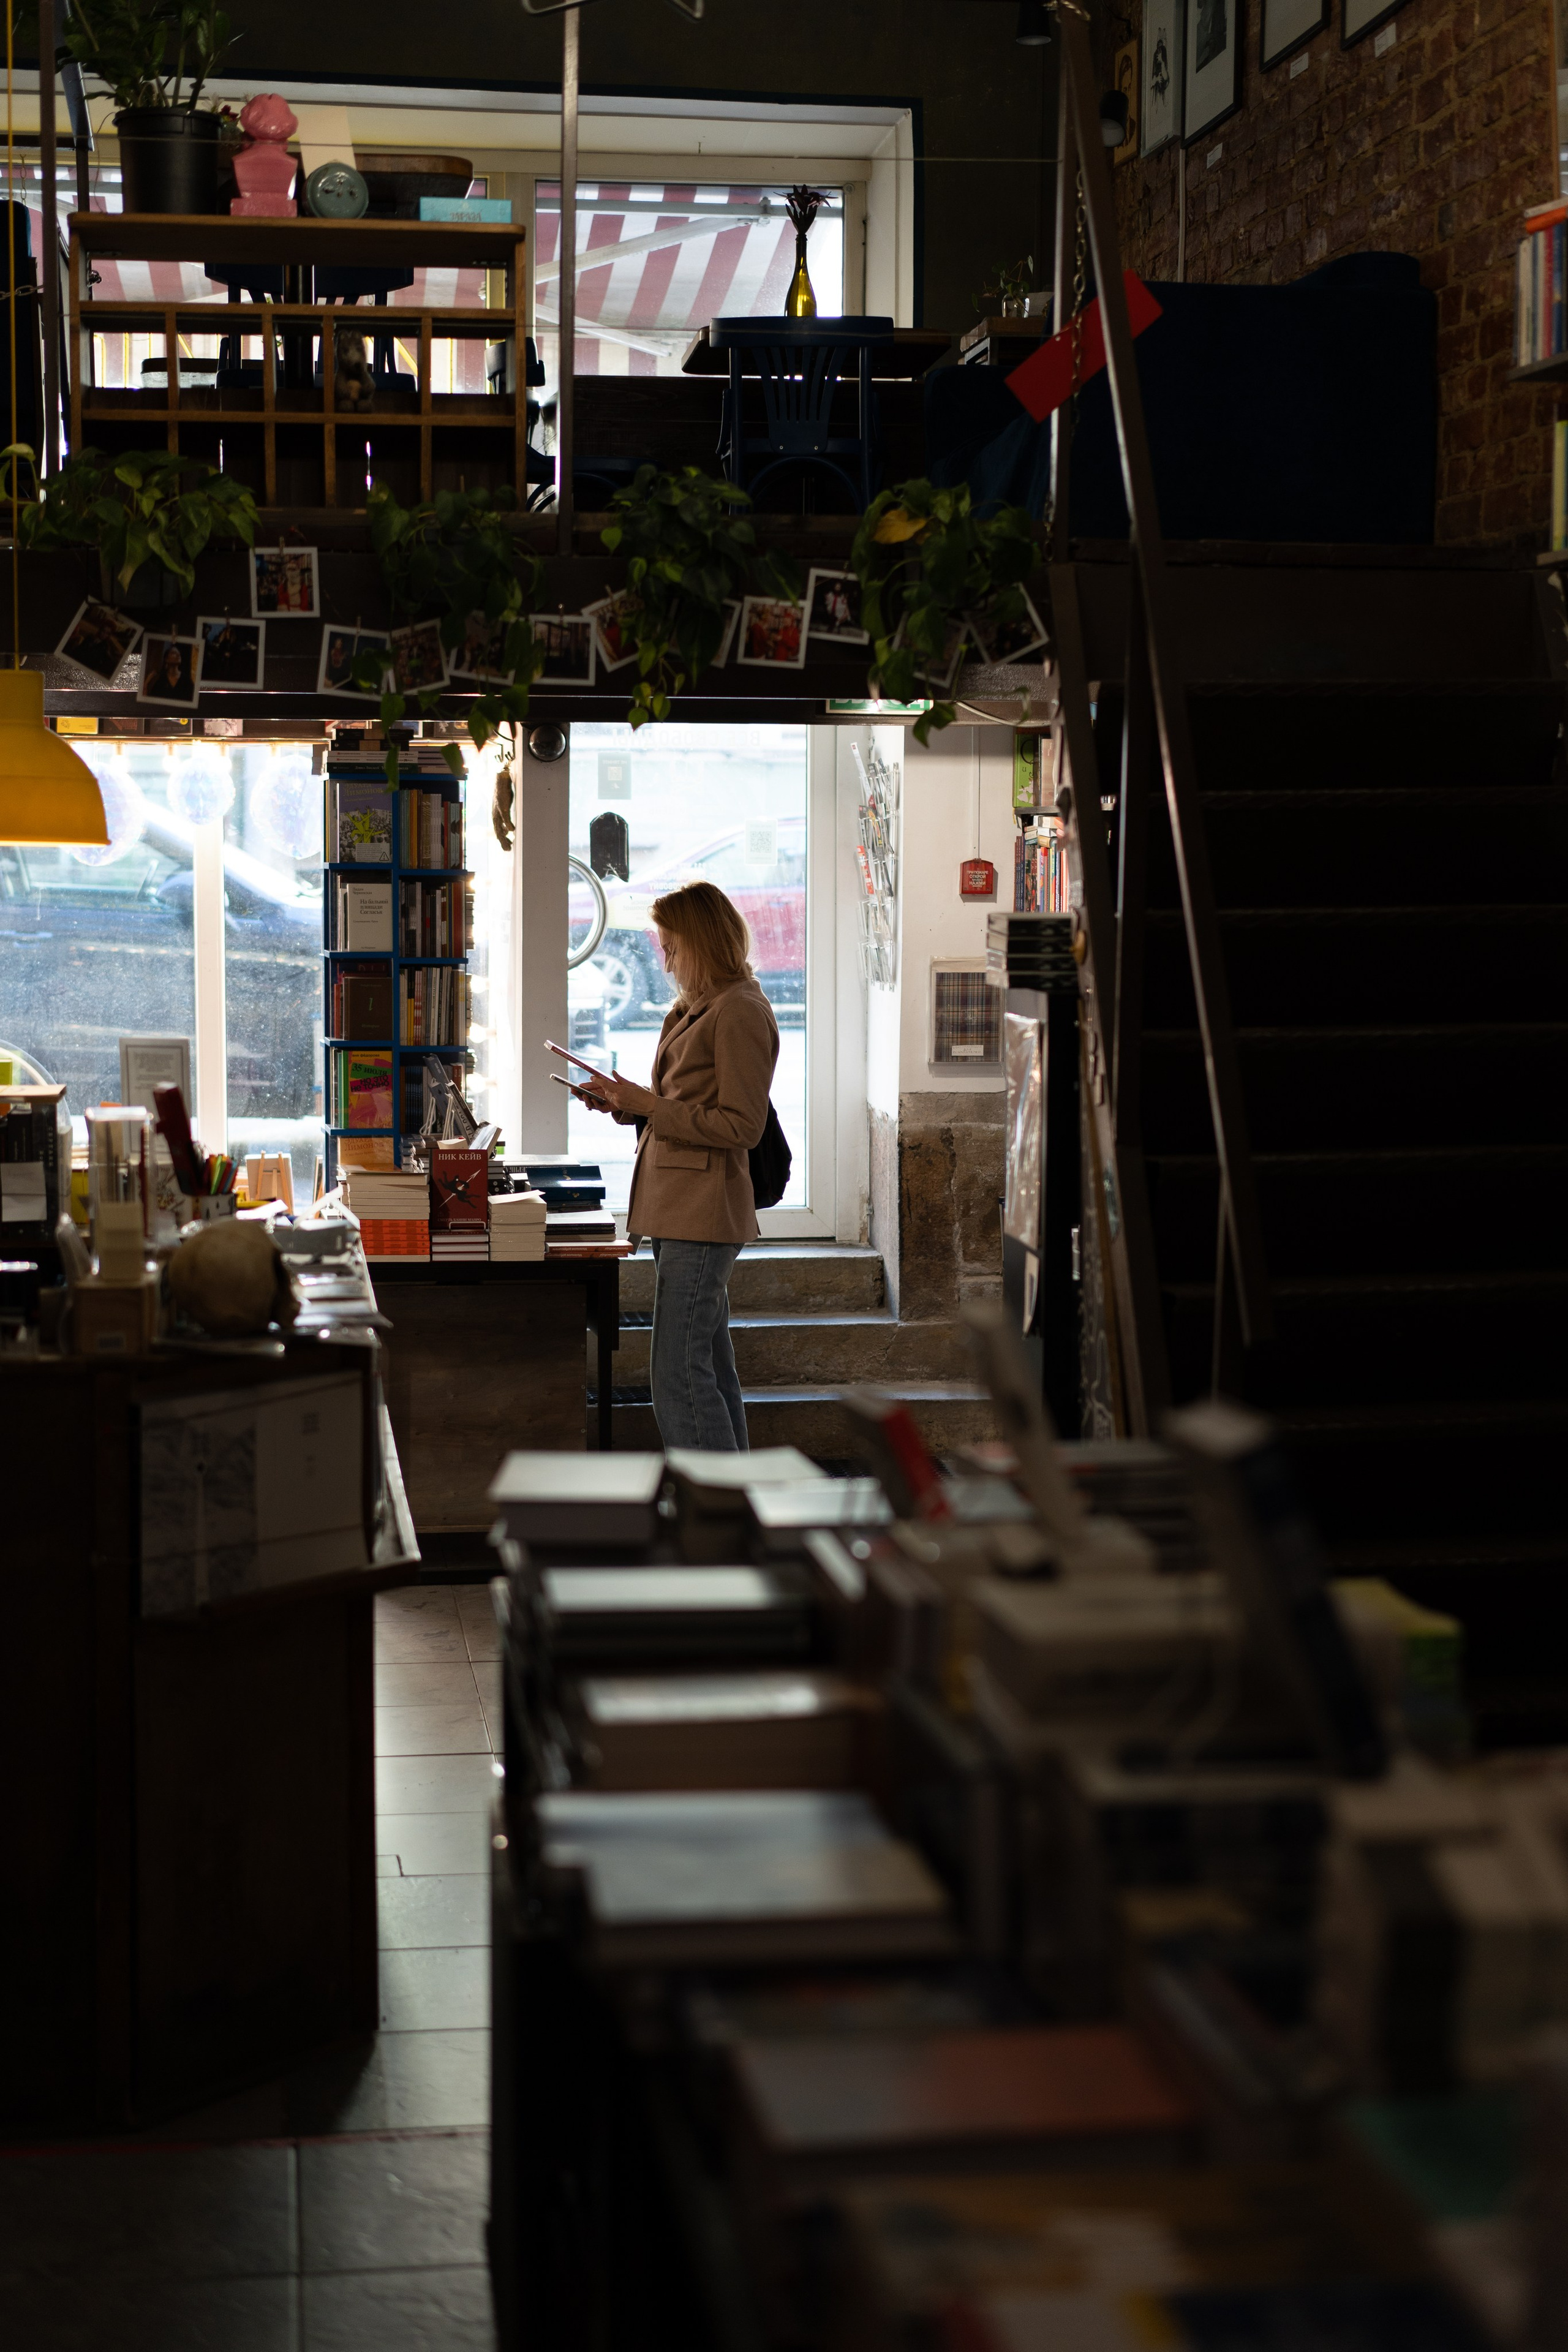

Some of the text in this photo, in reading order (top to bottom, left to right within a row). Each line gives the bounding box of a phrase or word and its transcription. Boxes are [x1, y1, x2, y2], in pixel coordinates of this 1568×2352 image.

[352, 1063, 387, 1076] 35 июля
[363, 1081, 389, 1090] точно
[459, 1152, 481, 1160] КЕЙВ
